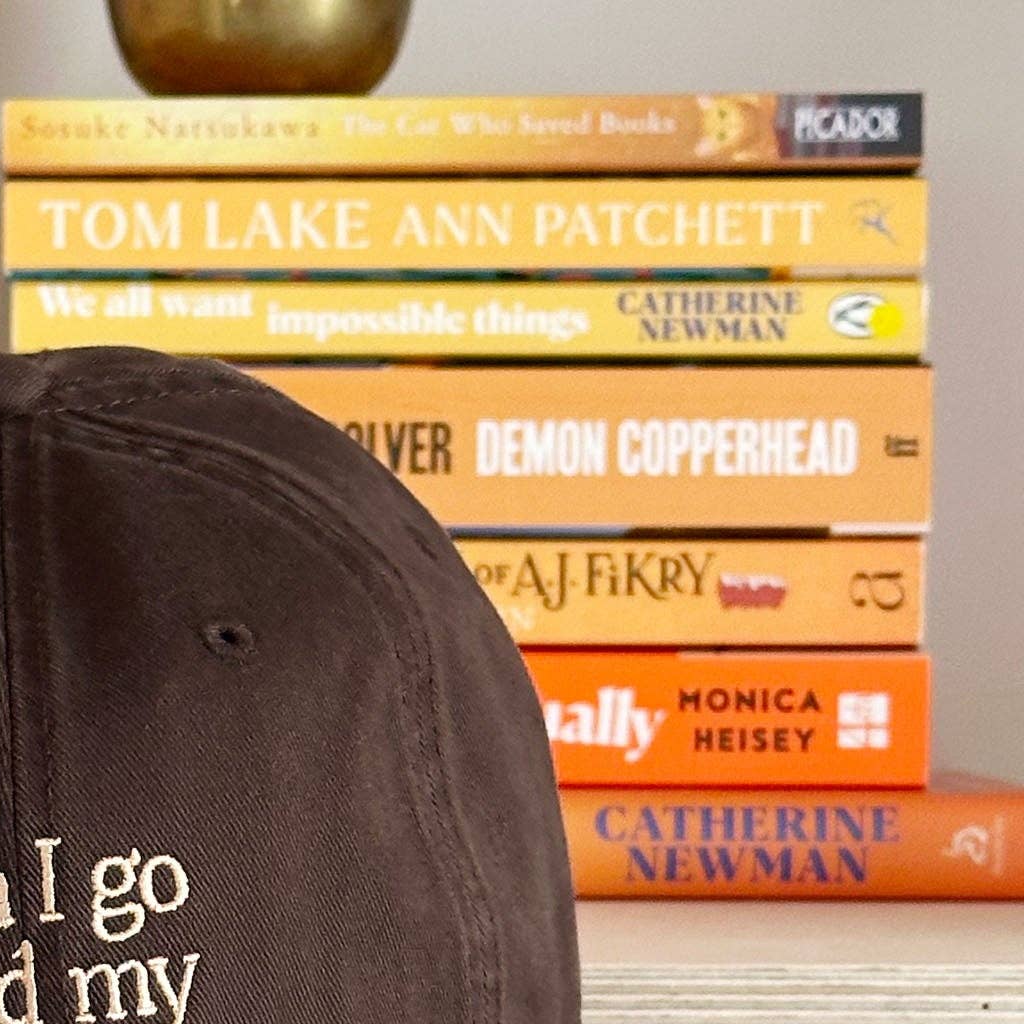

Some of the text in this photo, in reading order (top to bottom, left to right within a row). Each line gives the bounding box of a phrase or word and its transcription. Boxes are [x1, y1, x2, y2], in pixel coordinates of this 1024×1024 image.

[20, 111, 677, 140] Sosuke Natsukawa The Cat Who Saved Books
[794, 106, 900, 143] PICADOR
[38, 198, 824, 251] TOM LAKE ANN PATCHETT
[37, 284, 591, 342] We all want impossible things
[617, 288, 806, 317] CATHERINE
[640, 316, 788, 343] NEWMAN
[475, 418, 608, 477] DEMON
[616, 418, 858, 477] COPPERHEAD
[678, 687, 822, 714] MONICA
[693, 727, 815, 753] HEISEY
[594, 804, 902, 844] CATHERINE
[625, 846, 870, 884] NEWMAN
[34, 836, 65, 923] I
[90, 847, 190, 943] go
